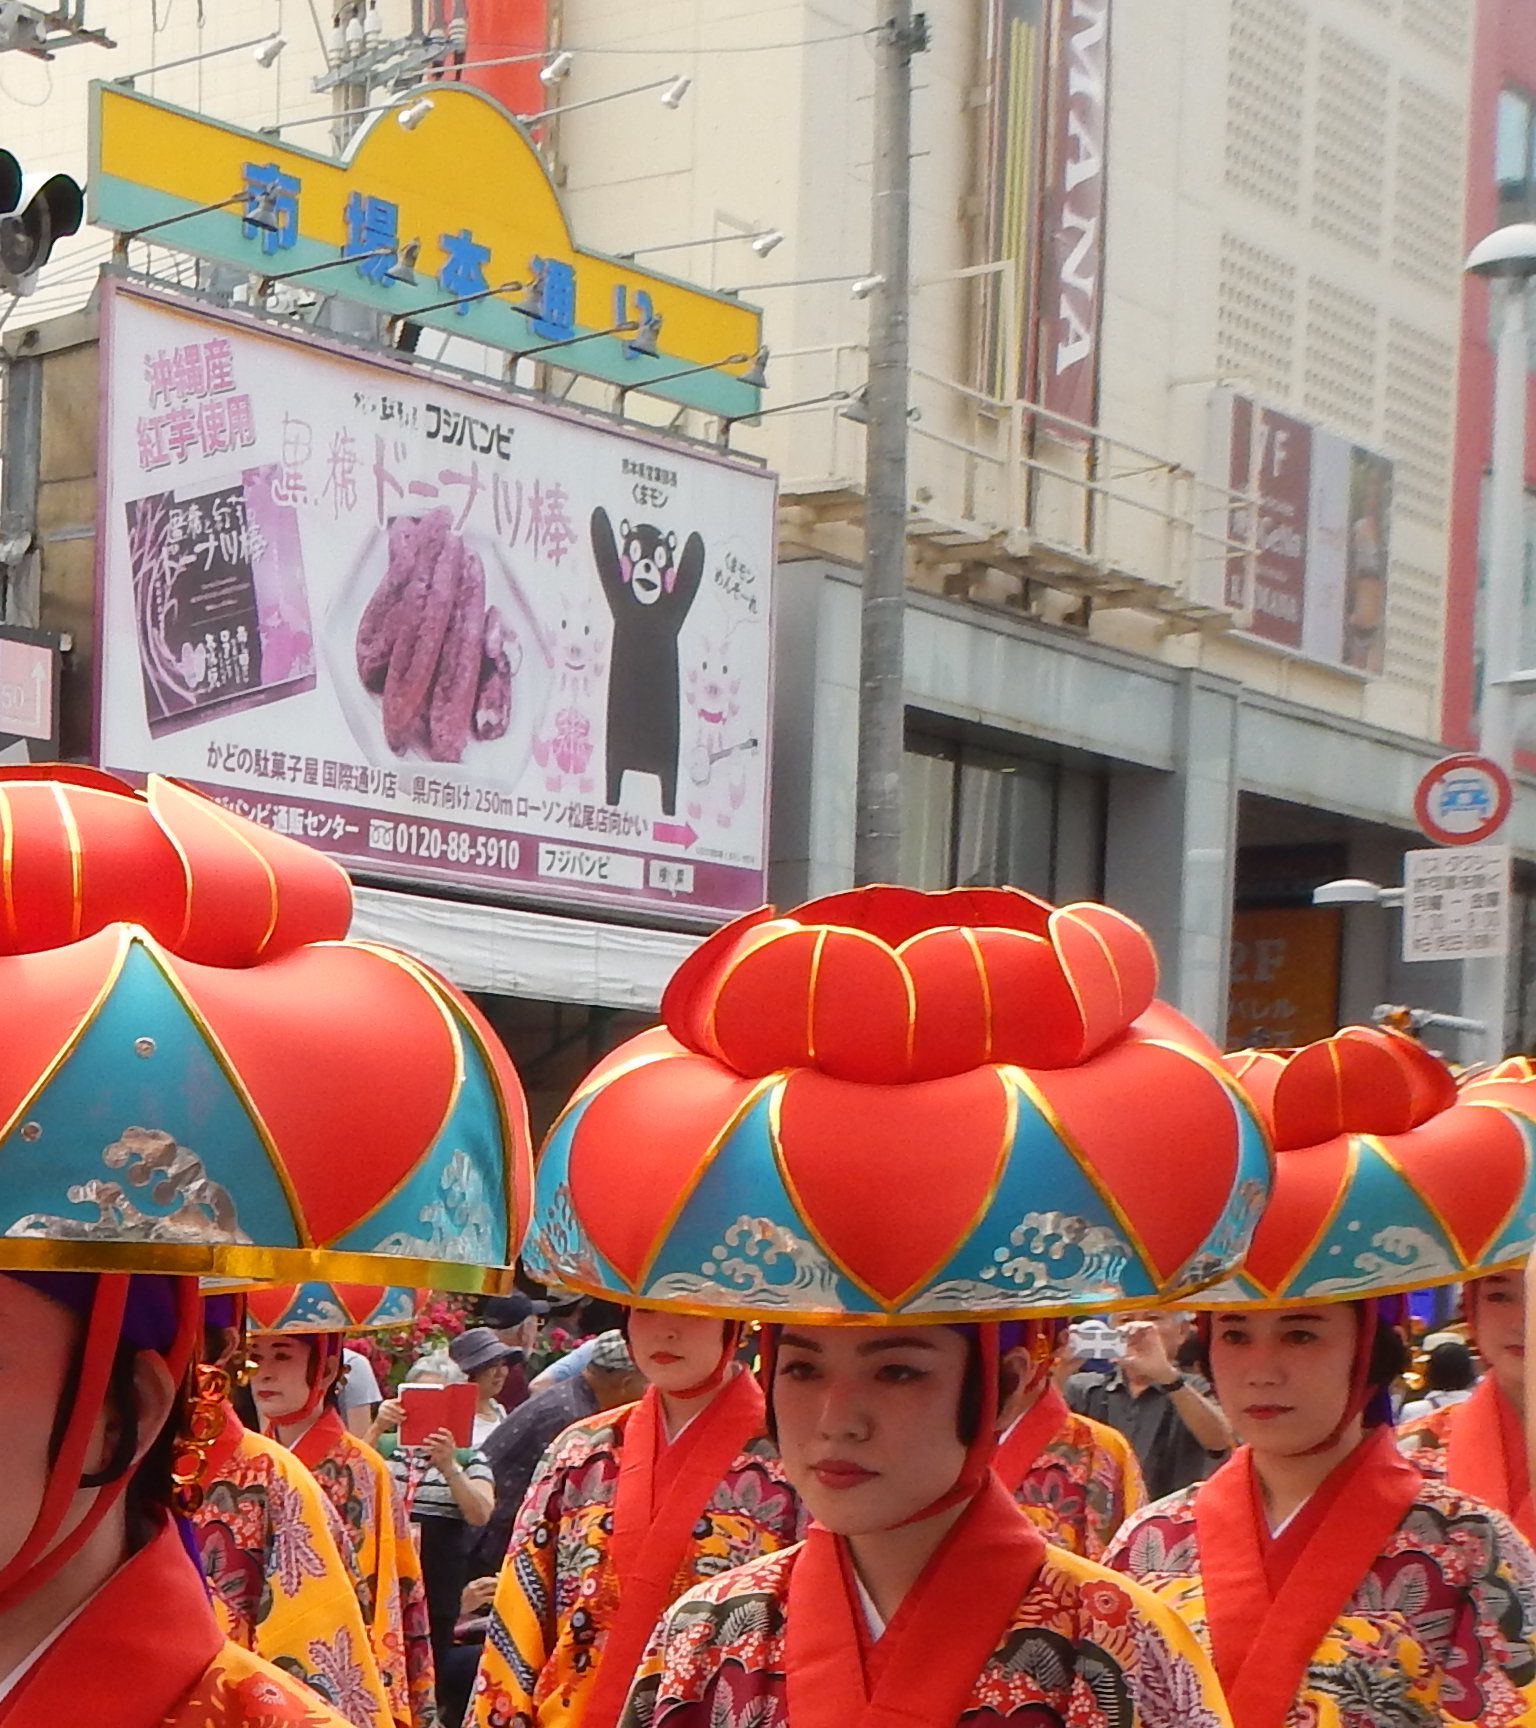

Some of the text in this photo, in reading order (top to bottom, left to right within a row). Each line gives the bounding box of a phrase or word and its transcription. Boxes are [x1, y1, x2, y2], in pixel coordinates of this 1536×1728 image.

[242, 162, 656, 360] 市場本通り
[145, 338, 235, 408] 沖縄産
[136, 393, 256, 471] 紅芋使用
[207, 741, 648, 838] かどの駄菓子屋 国際通り店 県庁向け 250m ローソン松尾店向かい
[396, 823, 520, 871] 0120-88-5910
[545, 849, 611, 880] フジバンビ
